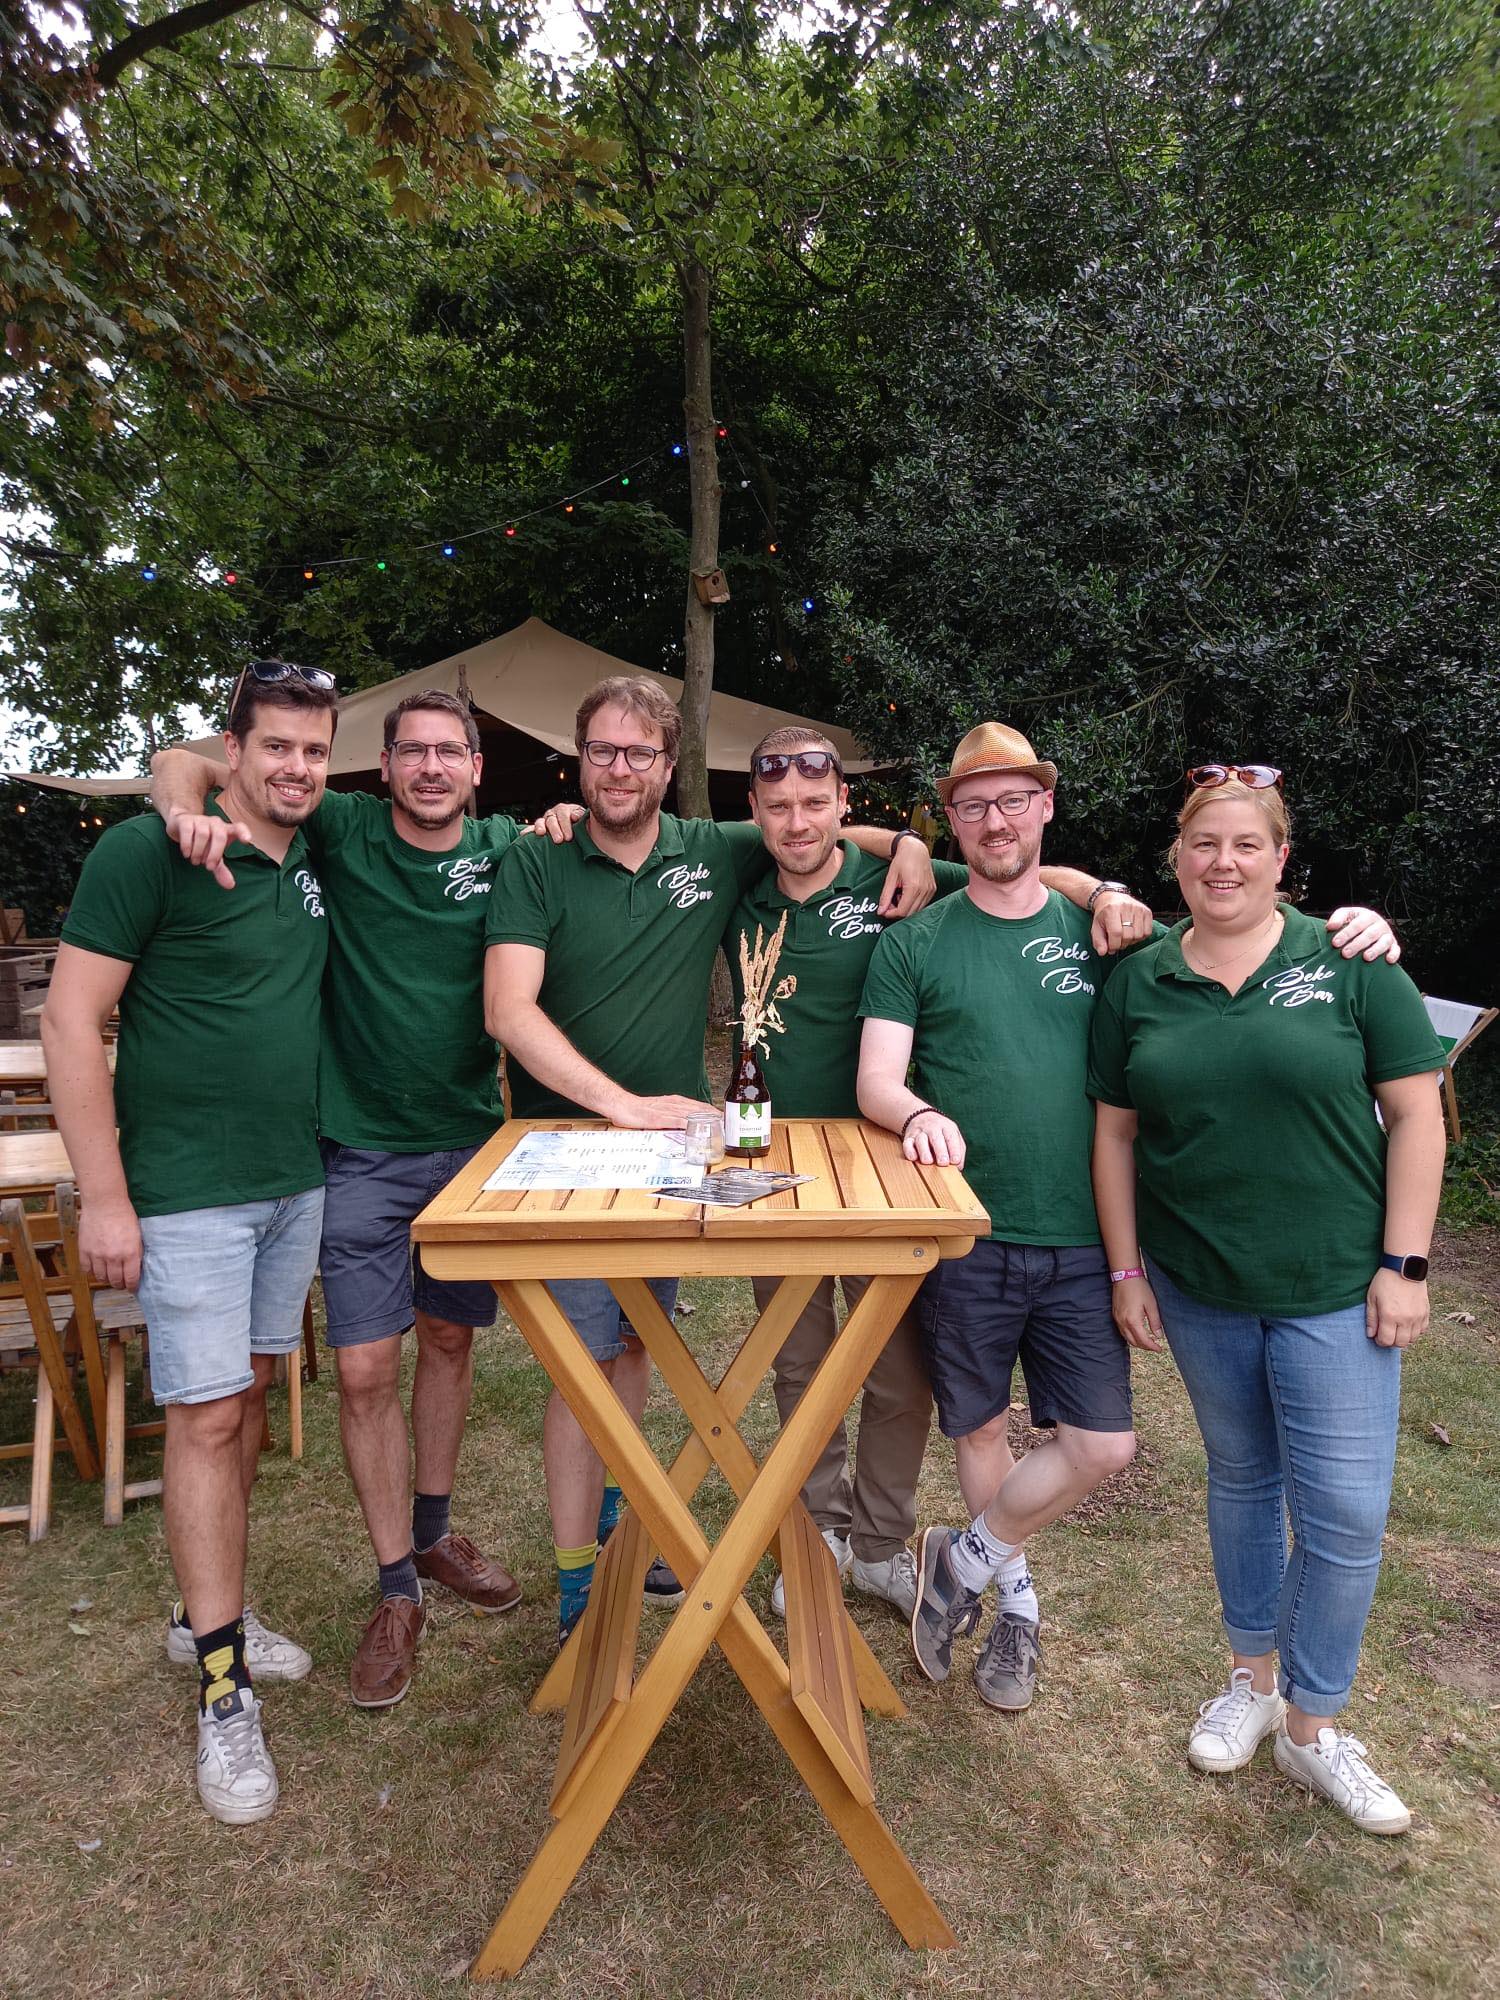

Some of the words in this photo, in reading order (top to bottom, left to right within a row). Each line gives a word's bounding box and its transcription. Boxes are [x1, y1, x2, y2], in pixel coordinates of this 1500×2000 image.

[437, 856, 491, 878] Beke
[657, 863, 710, 889] Beke
[444, 875, 491, 900] Bar
[668, 883, 713, 908] Bar
[819, 896, 878, 919] Beke
[829, 915, 883, 938] Bar
[1022, 937, 1090, 962] Beke
[1041, 967, 1095, 995] Bar
[1263, 965, 1336, 989] Beke
[1269, 984, 1335, 1007] Bar
